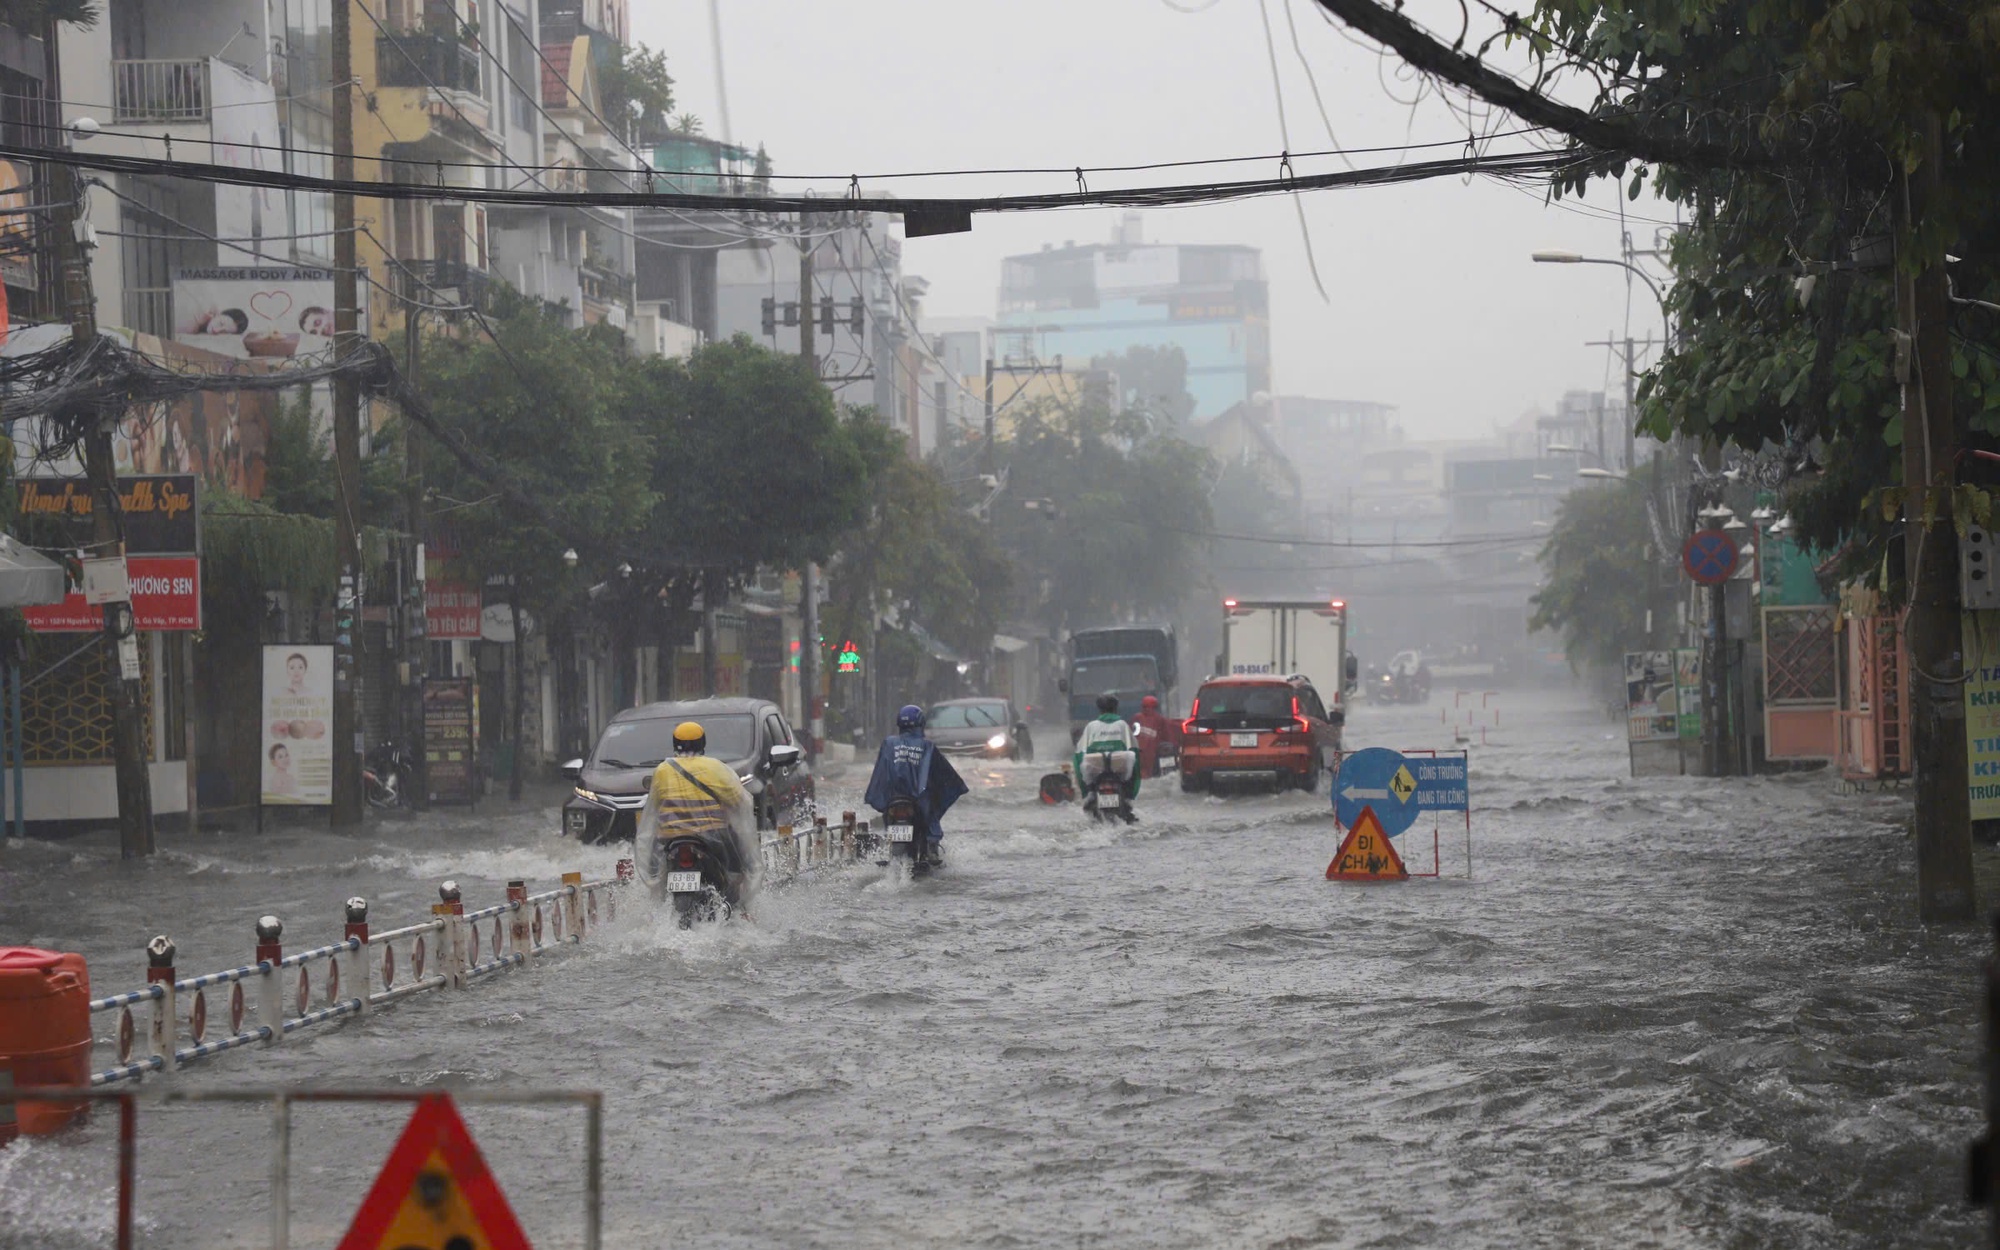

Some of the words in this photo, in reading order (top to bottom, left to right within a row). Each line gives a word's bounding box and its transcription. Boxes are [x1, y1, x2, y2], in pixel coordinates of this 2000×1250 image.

[180, 269, 246, 280] MASSAGE
[250, 269, 288, 280] BODY
[292, 269, 322, 280] AND
[159, 480, 190, 519] Spa
[173, 577, 193, 595] SEN
[179, 616, 194, 625] HCM
[1419, 762, 1436, 780] CÔNG
[1438, 762, 1464, 780] TRƯỜNG
[1417, 789, 1435, 804] ĐANG
[1436, 789, 1447, 804] THI
[1448, 787, 1466, 804] CÔNG
[1358, 835, 1374, 850] ĐI
